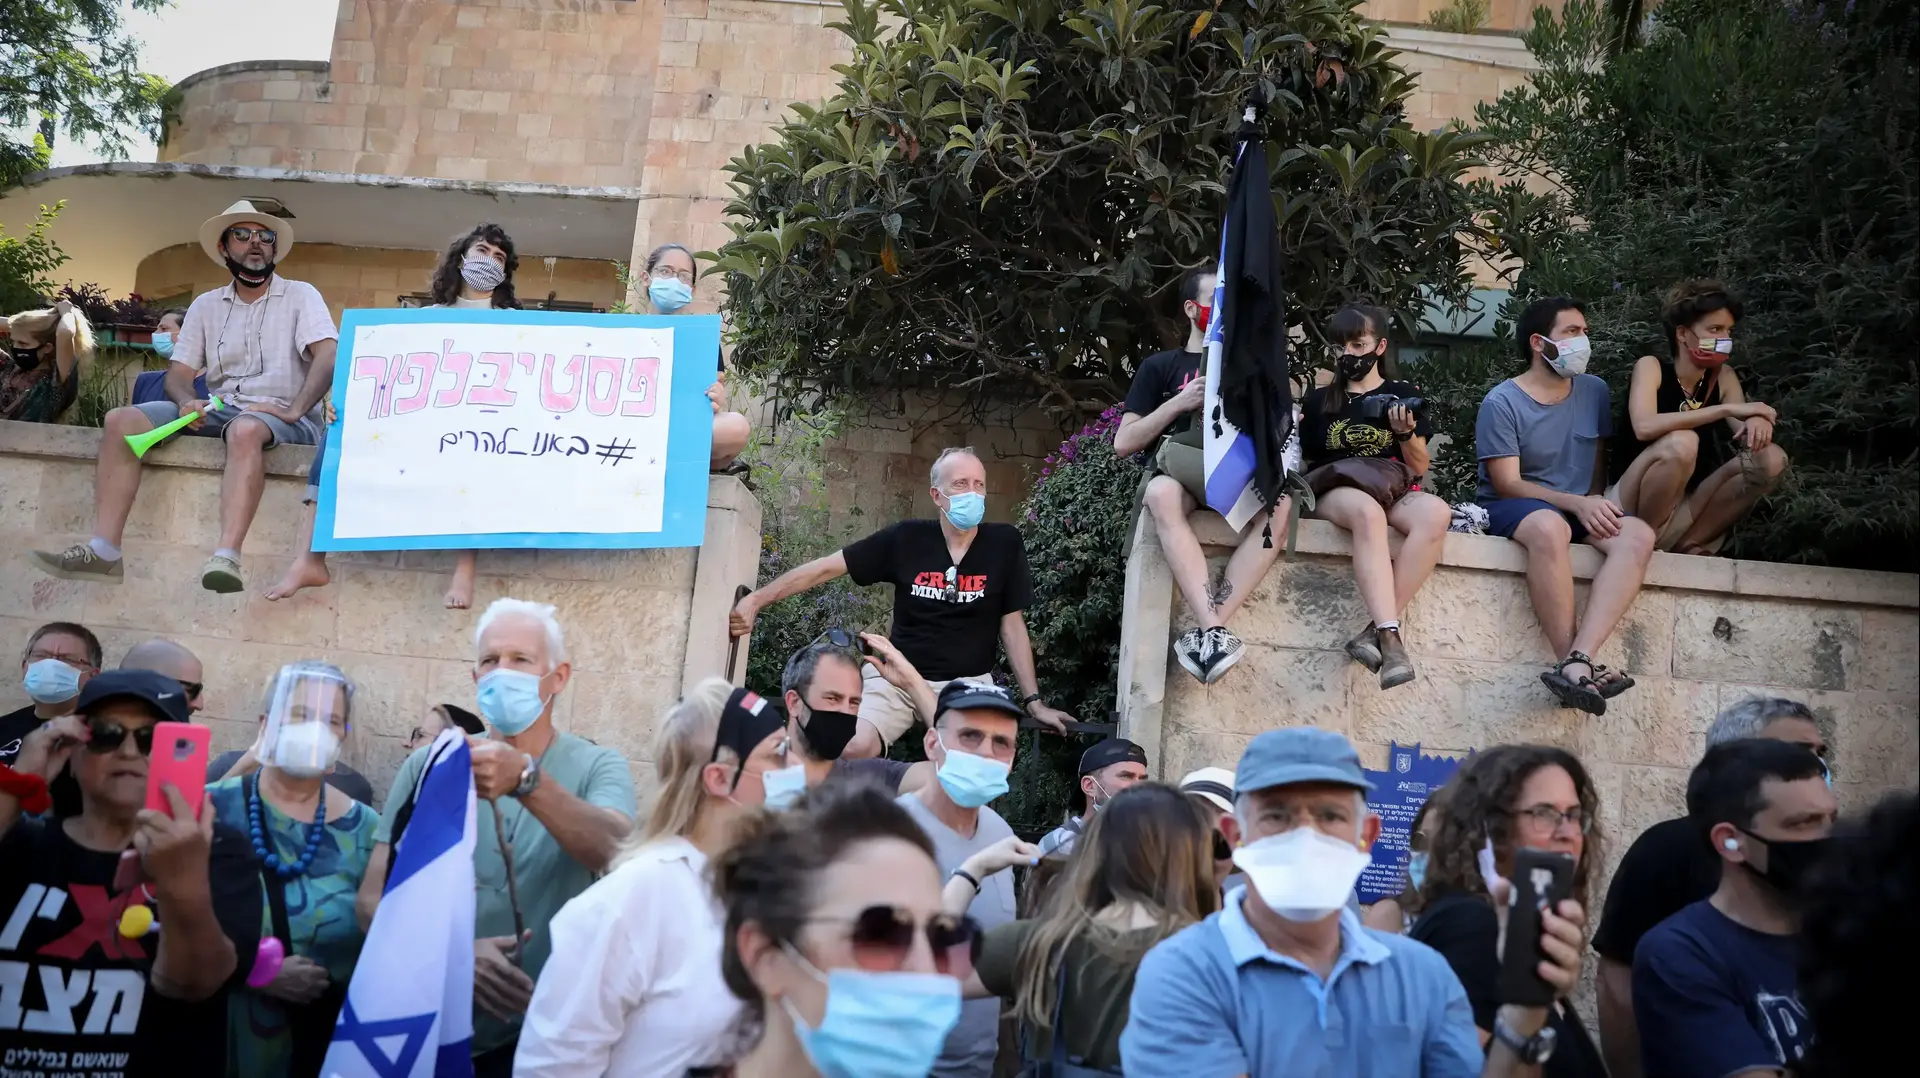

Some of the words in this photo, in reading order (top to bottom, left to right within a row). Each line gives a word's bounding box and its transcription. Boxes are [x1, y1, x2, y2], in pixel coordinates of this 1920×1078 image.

[439, 427, 636, 466] #באנו_להרים
[913, 571, 987, 591] CRME
[910, 584, 984, 603] MINTER
[4, 1046, 68, 1068] בפלילים
[71, 1051, 130, 1068] שנאשם
